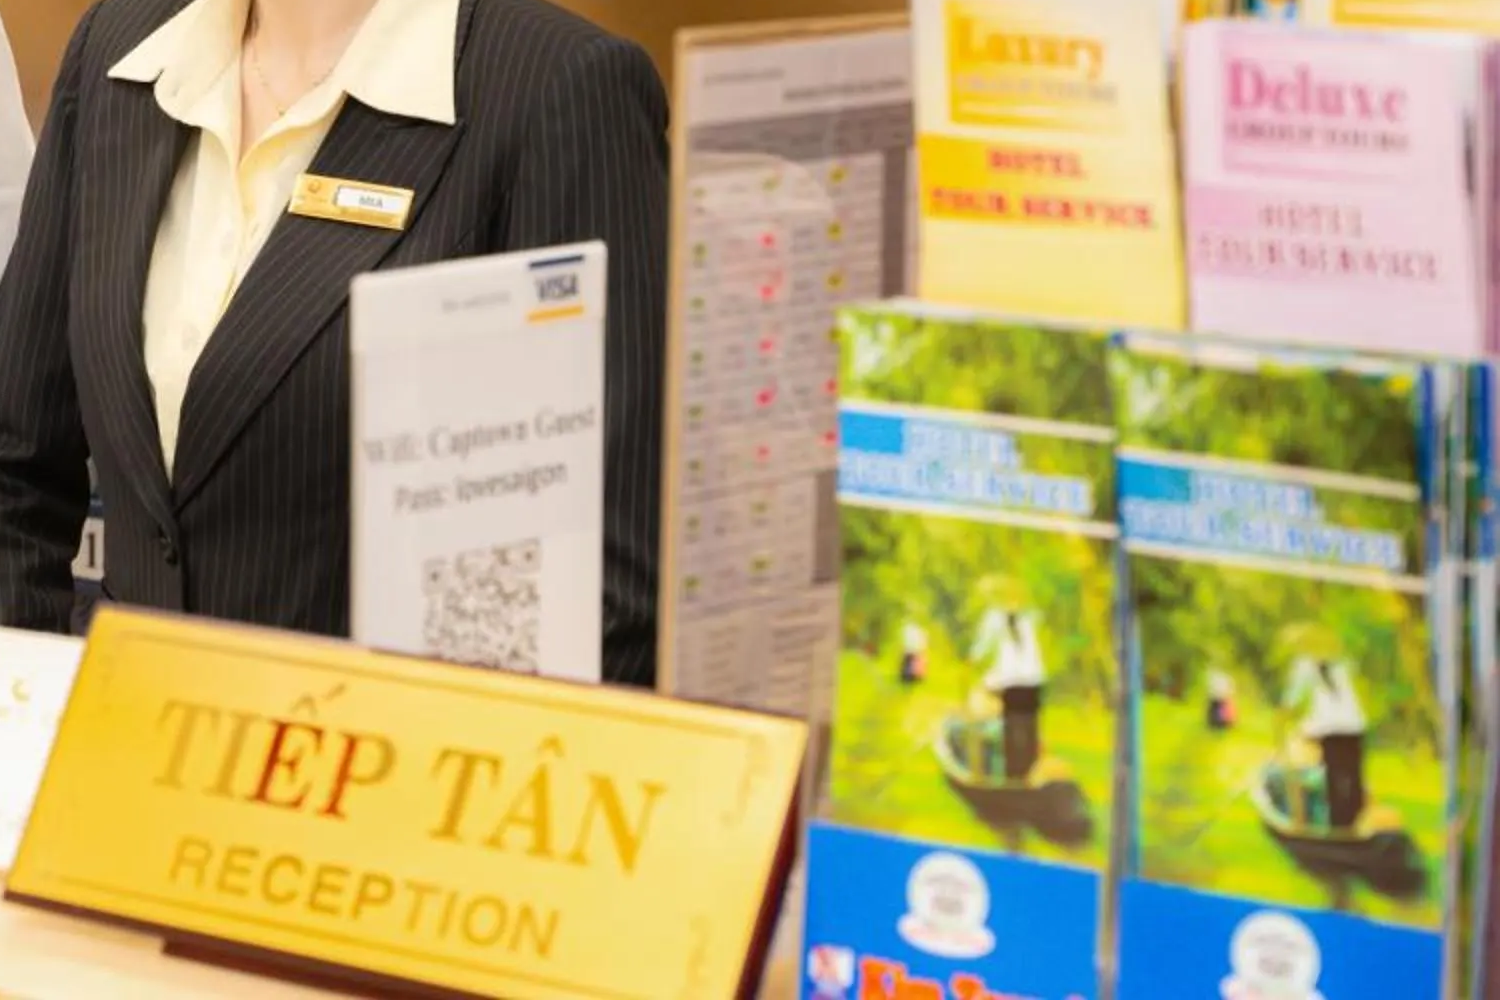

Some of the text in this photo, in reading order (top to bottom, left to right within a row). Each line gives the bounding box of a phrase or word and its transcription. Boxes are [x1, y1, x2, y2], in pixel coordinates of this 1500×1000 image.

[956, 16, 1105, 82] Luxury
[1227, 58, 1408, 123] Deluxe
[533, 272, 581, 303] VISA
[153, 682, 668, 880] TIẾP TÂN
[168, 835, 561, 961] RECEPTION
